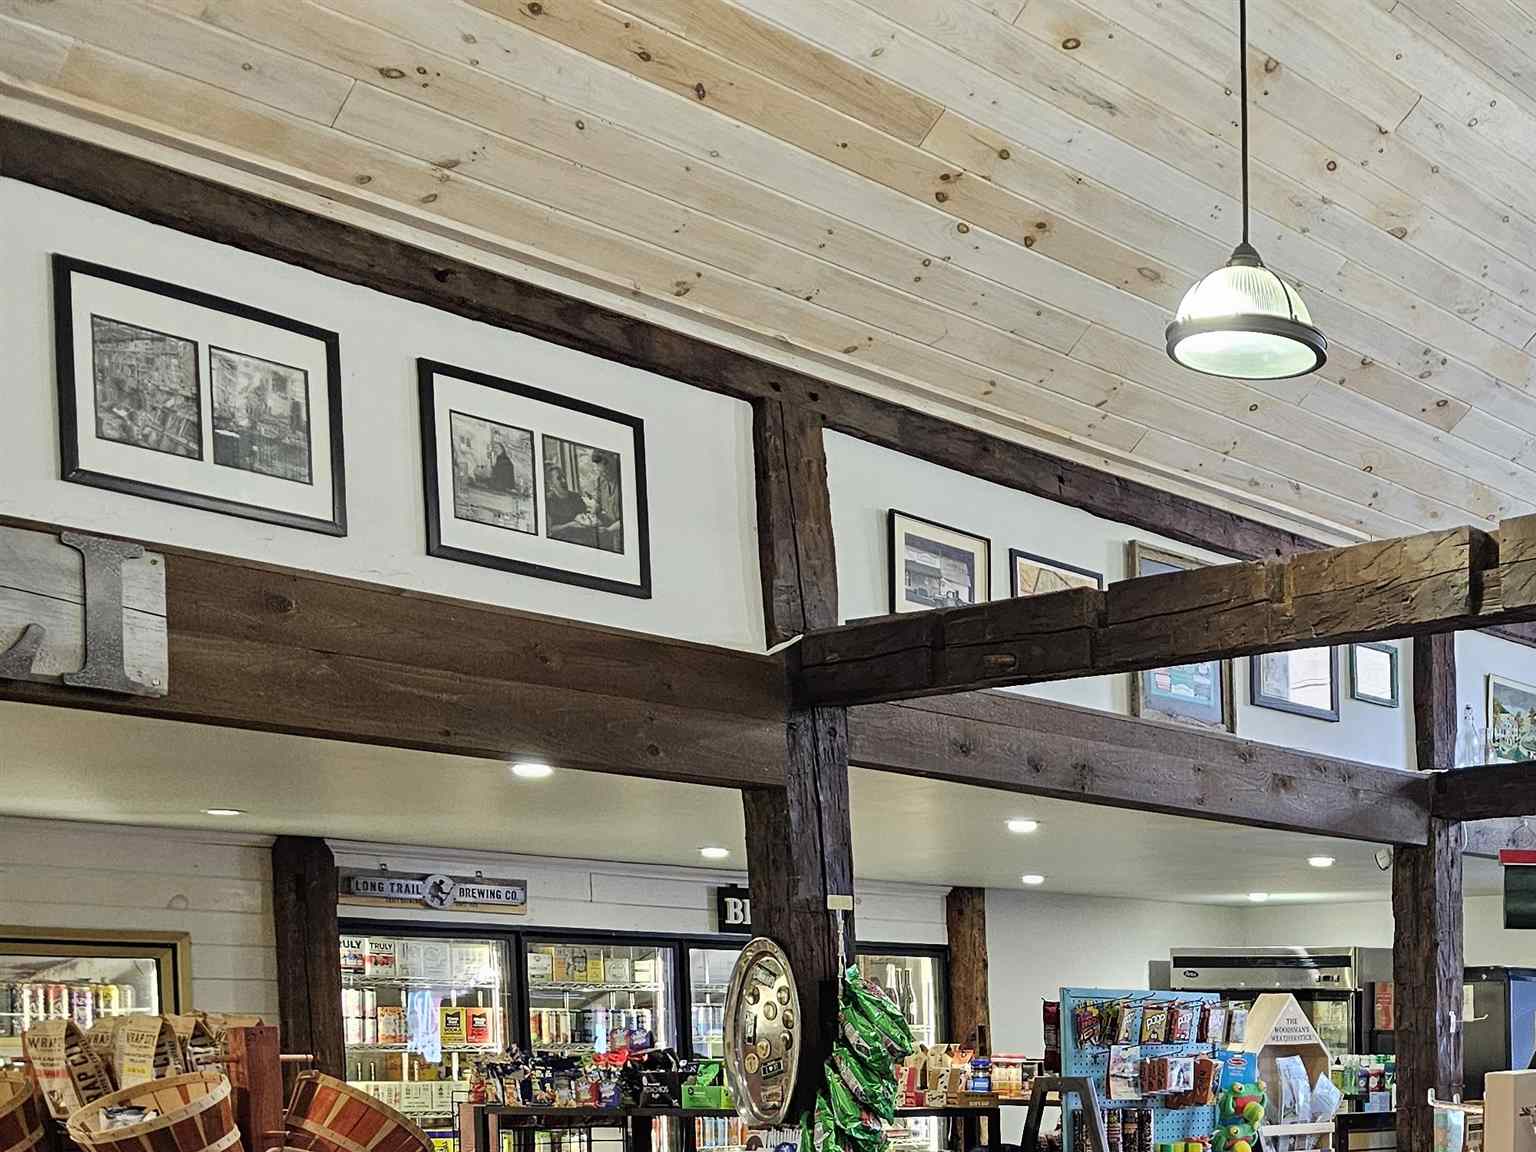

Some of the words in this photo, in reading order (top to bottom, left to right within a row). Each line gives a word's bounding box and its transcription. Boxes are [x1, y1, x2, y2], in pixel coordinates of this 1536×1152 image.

[355, 879, 384, 892] LONG
[389, 881, 422, 895] TRAIL
[458, 887, 502, 899] BREWING
[369, 942, 393, 950] TRULY
